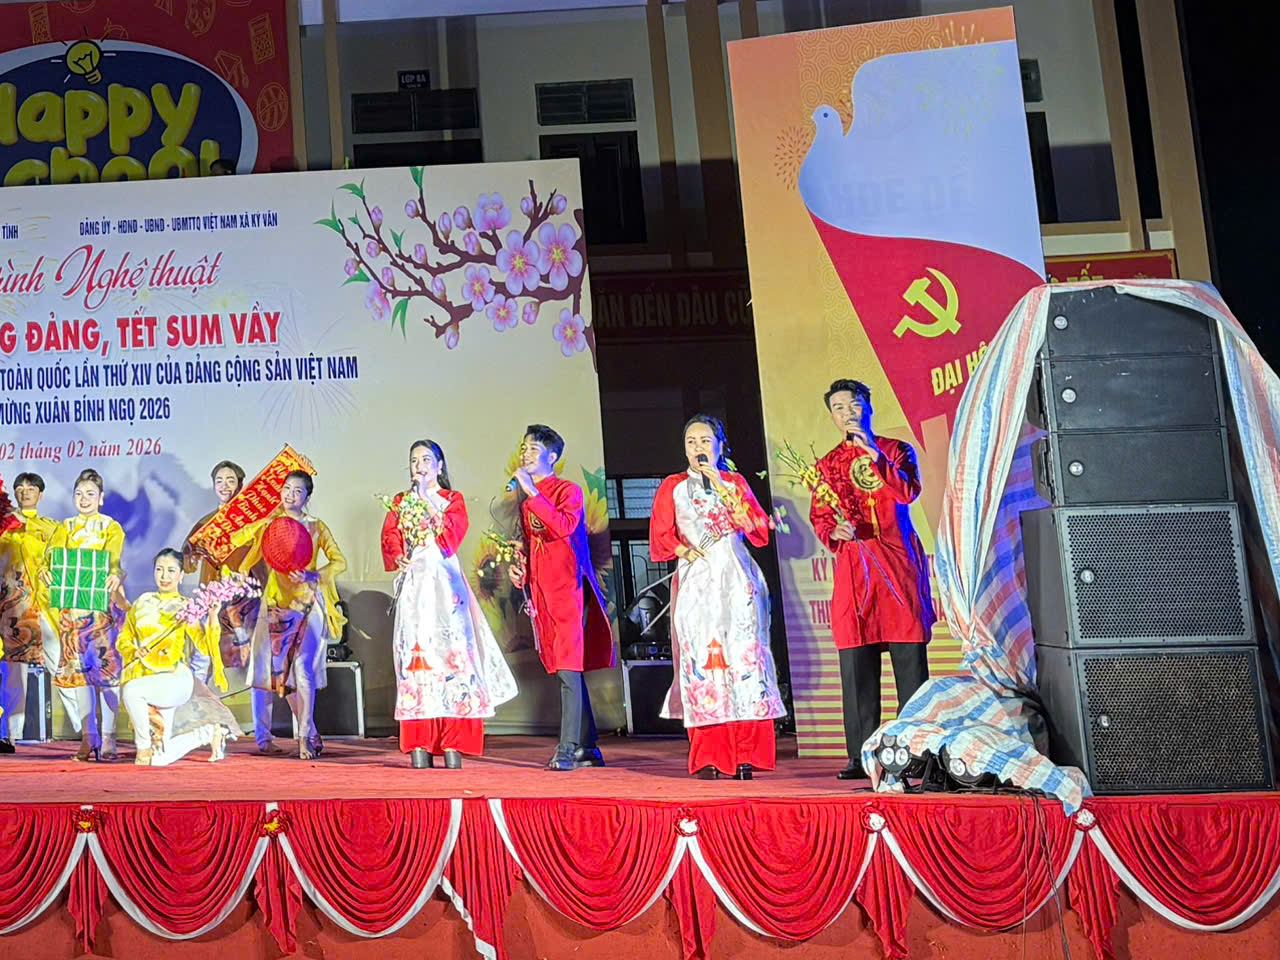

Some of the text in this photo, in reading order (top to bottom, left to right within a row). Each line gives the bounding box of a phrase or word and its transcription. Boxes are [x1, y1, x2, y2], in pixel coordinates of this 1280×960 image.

[55, 244, 146, 311] Nghệ
[149, 249, 223, 294] thuật
[25, 311, 109, 357] ĐẢNG,
[117, 305, 157, 349] TẾT
[167, 313, 223, 347] SUM
[229, 301, 282, 344] VẦY
[0, 365, 32, 390] TOÀN
[37, 358, 70, 391] QUỐC
[75, 356, 99, 388] LẦN
[103, 359, 128, 386] THỨ
[132, 362, 152, 386] XIV
[156, 353, 182, 385] CỦA
[185, 353, 221, 383] ĐẢNG
[225, 355, 261, 387] CỘNG
[265, 350, 292, 381] SẢN
[296, 352, 323, 385] VIỆT
[327, 355, 358, 379] NAM
[931, 358, 963, 396] ĐẠI
[35, 395, 70, 424] XUÂN
[74, 394, 105, 422] BÍNH
[109, 398, 136, 426] NGỌ
[139, 397, 170, 420] 2026
[19, 440, 62, 463] tháng
[67, 440, 84, 458] 02
[88, 438, 120, 457] năm
[126, 437, 161, 456] 2026
